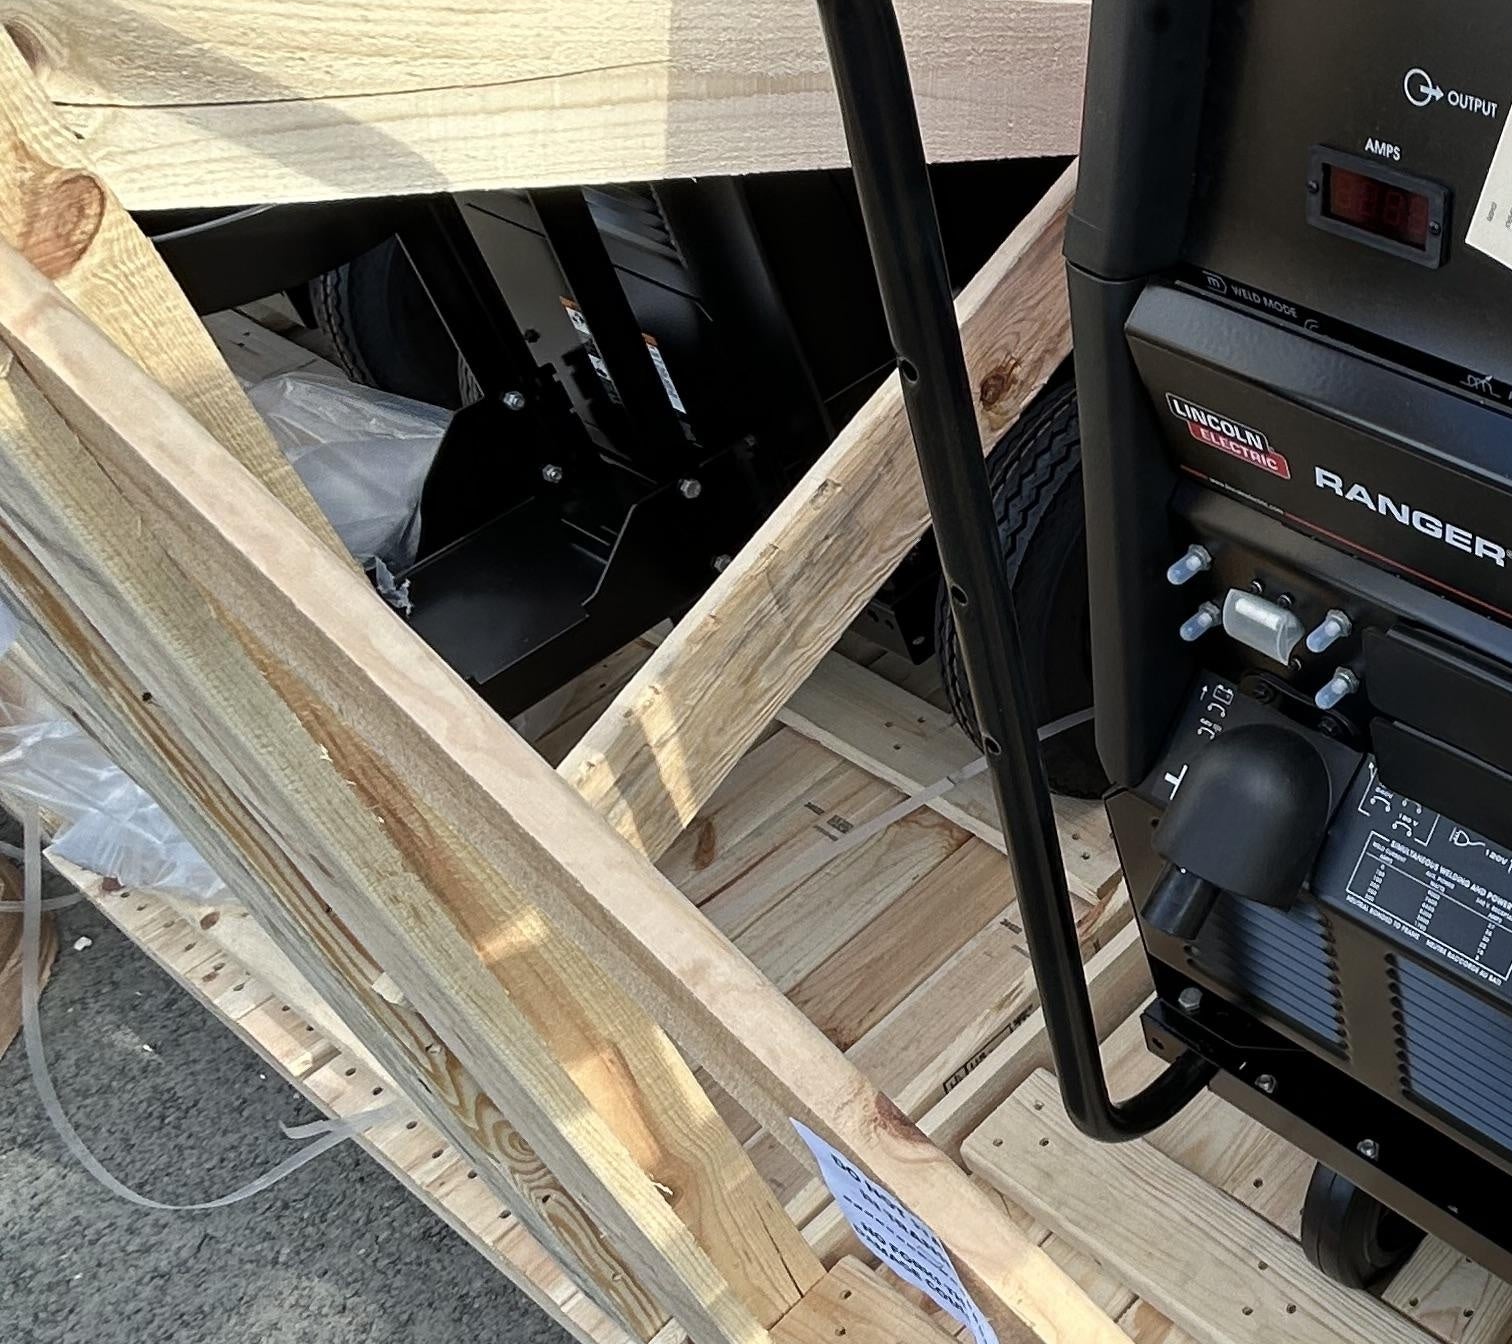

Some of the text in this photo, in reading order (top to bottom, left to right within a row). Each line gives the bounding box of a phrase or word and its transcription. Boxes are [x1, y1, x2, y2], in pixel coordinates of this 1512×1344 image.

[1448, 90, 1497, 118] OUTPUT
[1364, 137, 1400, 161] AMPS
[1230, 284, 1298, 318] WELD MODE
[1173, 399, 1263, 451] LINCOLN
[1200, 428, 1279, 471] ELECTRIC
